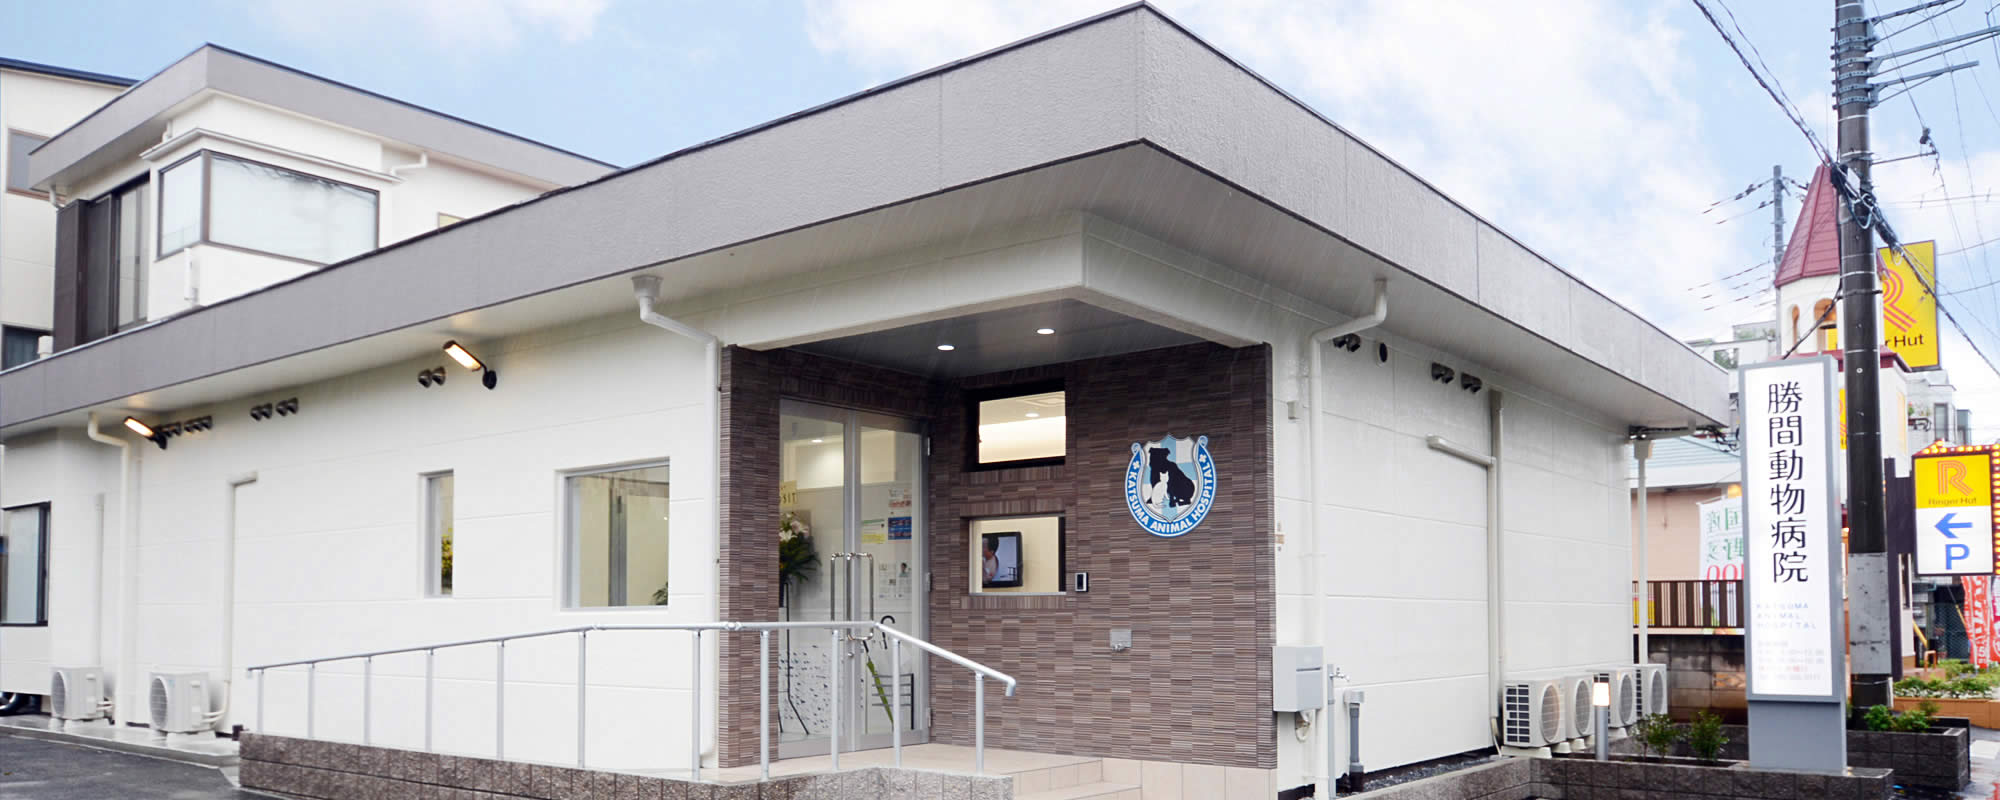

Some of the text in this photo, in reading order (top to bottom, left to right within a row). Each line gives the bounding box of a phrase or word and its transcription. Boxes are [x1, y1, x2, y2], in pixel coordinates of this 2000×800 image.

[1894, 334, 1924, 348] Hut
[1767, 381, 1809, 583] 勝間動物病院
[1128, 464, 1213, 533] KATSUMA ANIMAL HOSPITAL
[1928, 497, 1977, 506] Ringer Hut
[1945, 543, 1970, 570] P
